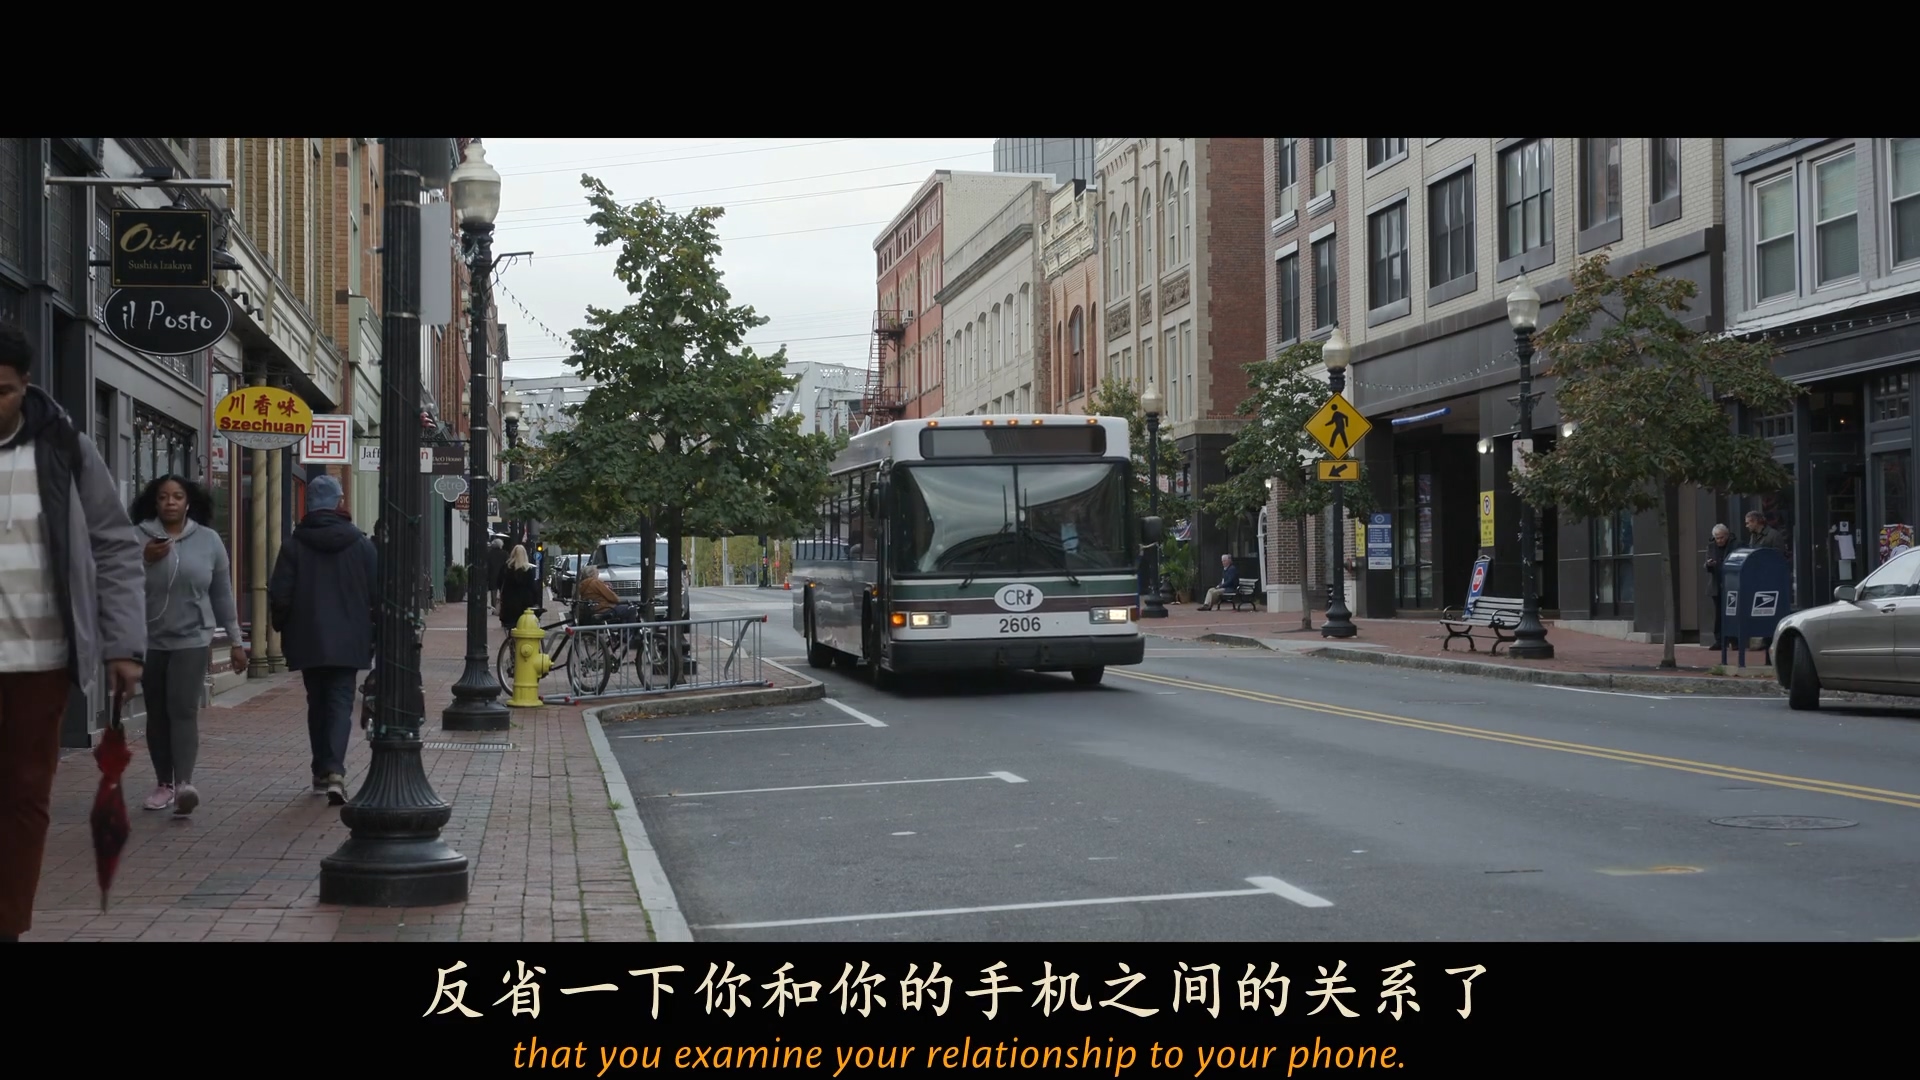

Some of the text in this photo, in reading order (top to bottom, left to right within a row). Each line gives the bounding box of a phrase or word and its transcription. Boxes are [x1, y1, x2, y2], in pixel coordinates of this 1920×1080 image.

[120, 223, 202, 252] Oishi
[128, 260, 152, 270] Sushi
[160, 261, 192, 273] Izakaya
[122, 300, 212, 332] il Posto
[228, 393, 300, 418] 川香味
[220, 416, 306, 434] Szechuan
[361, 446, 381, 460] Jaff
[999, 616, 1042, 634] 2606
